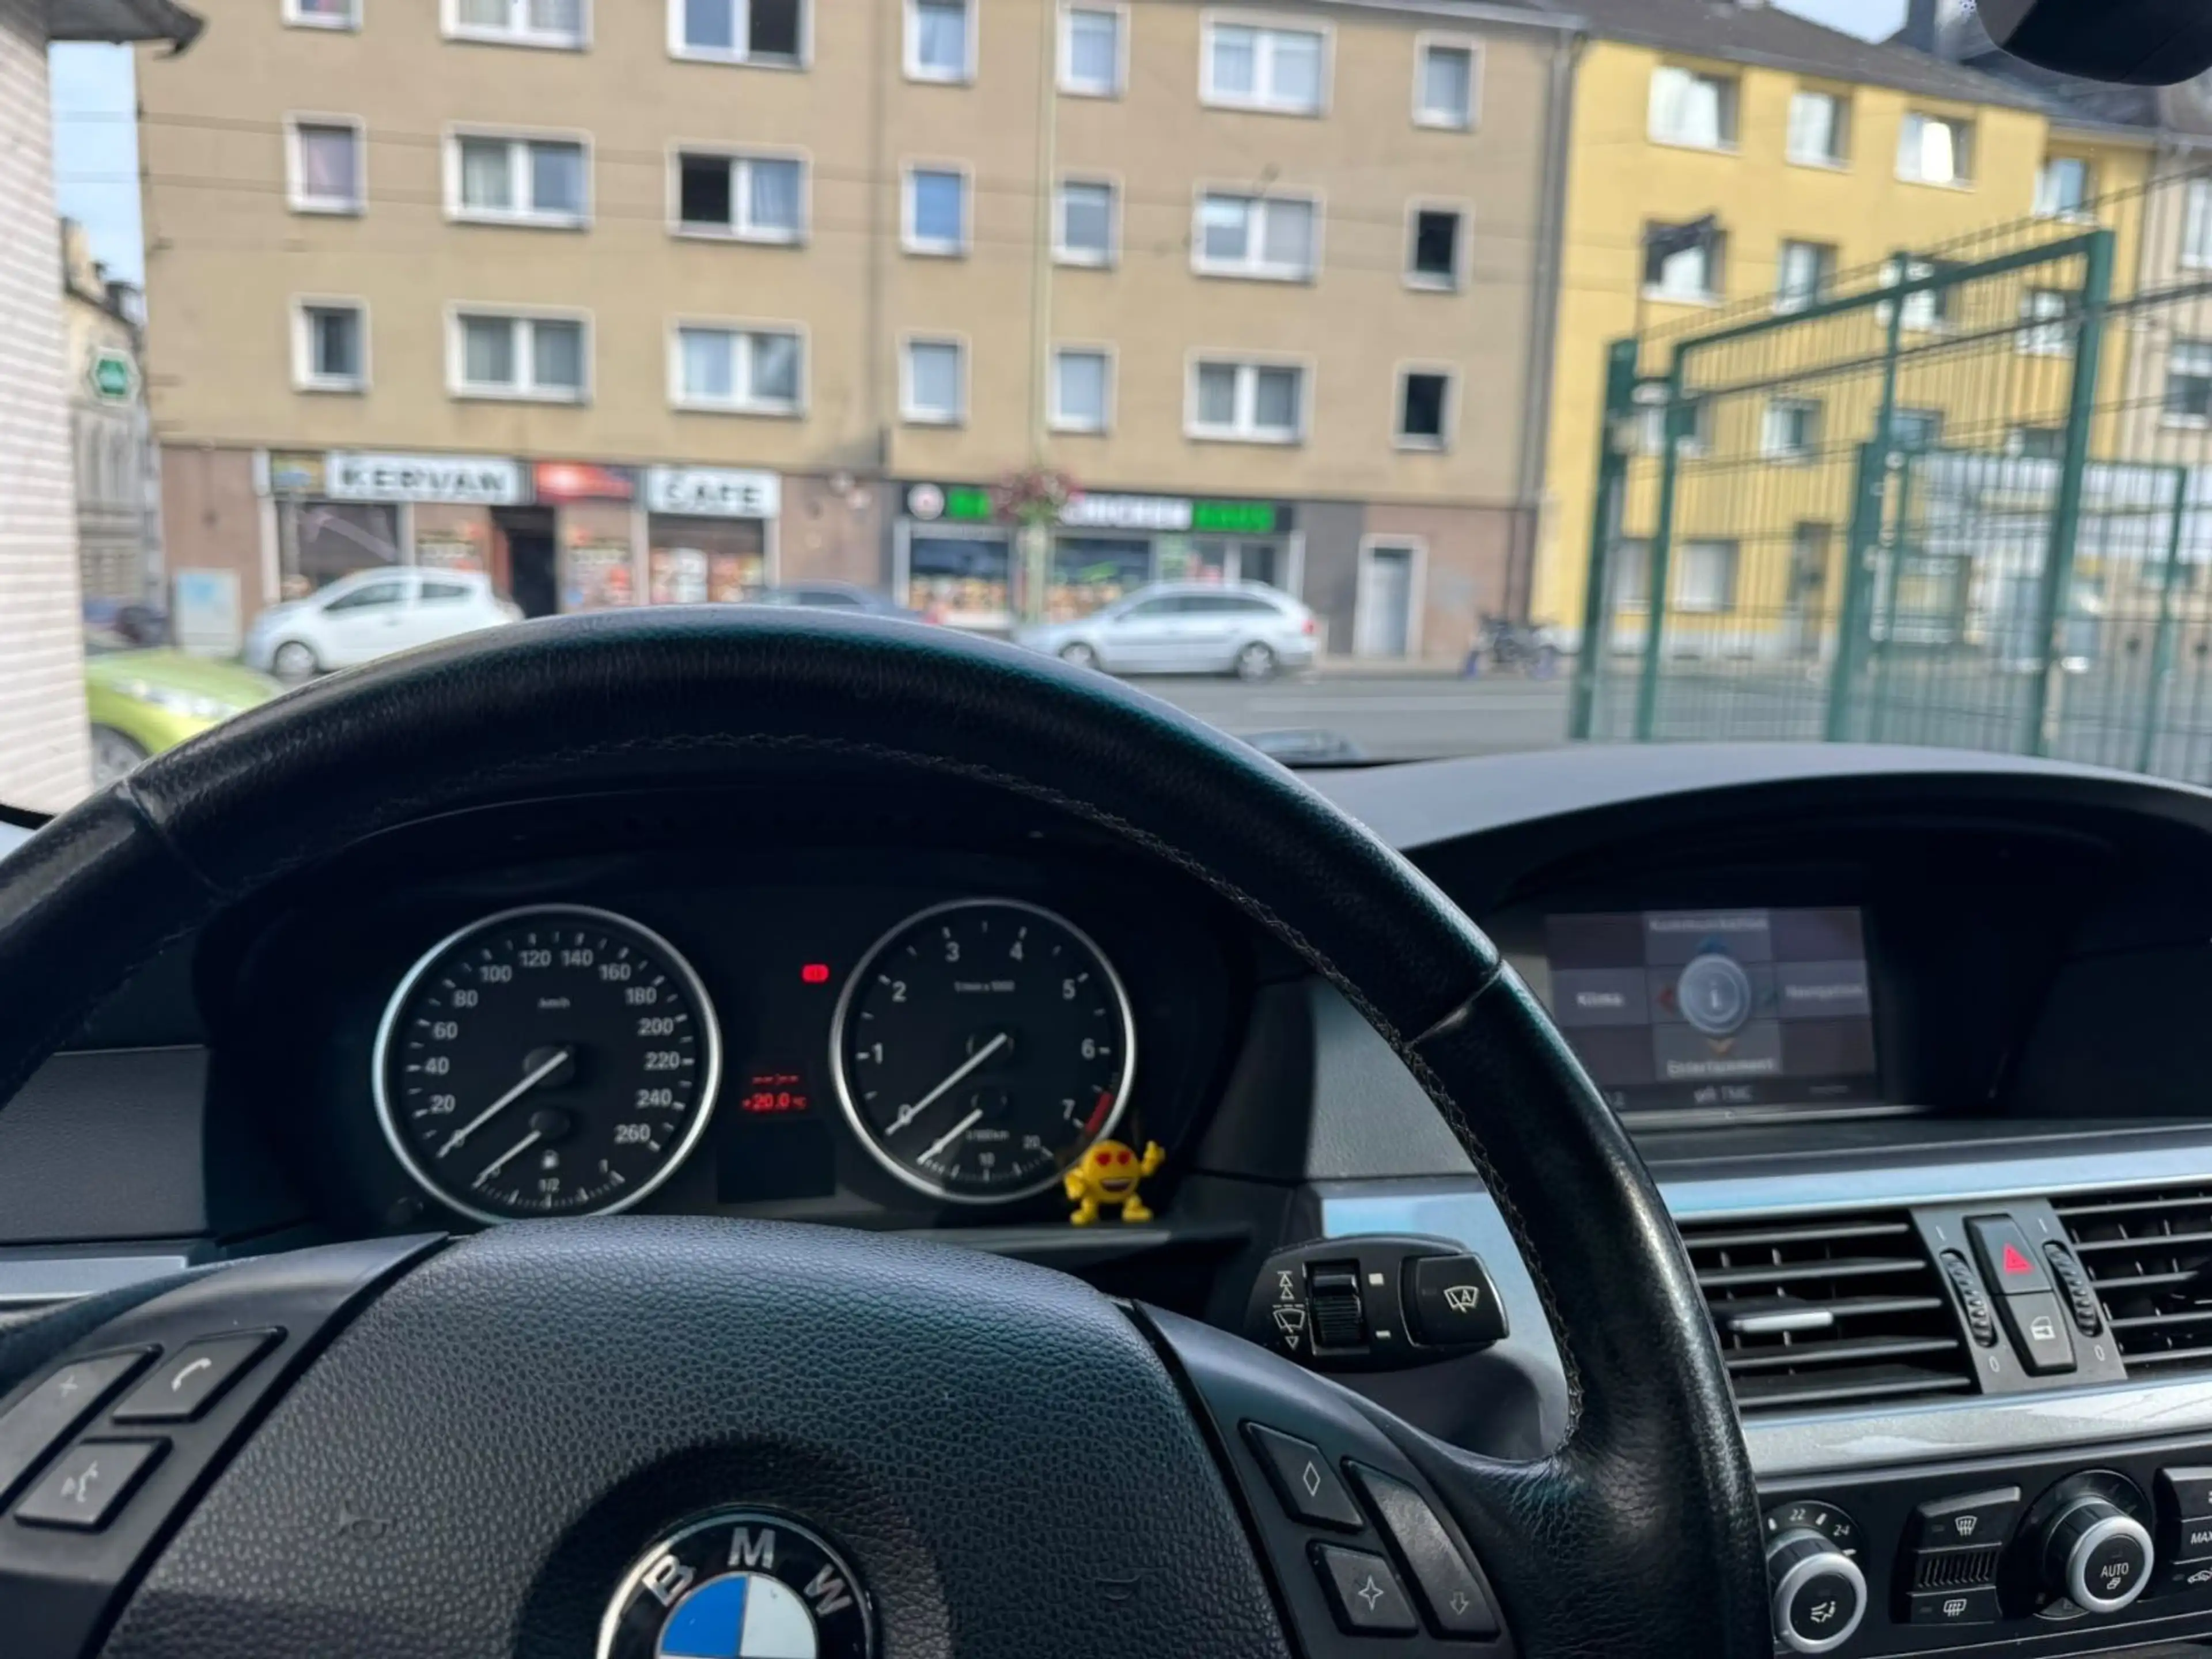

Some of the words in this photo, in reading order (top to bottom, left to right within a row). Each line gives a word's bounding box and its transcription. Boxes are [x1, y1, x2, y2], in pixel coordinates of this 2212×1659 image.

[520, 949, 552, 967] 120
[561, 949, 594, 967] 140
[945, 941, 960, 962] 3
[1010, 941, 1023, 961] 4
[480, 964, 513, 982] 100
[599, 963, 631, 980] 160
[453, 989, 479, 1007] 80
[625, 986, 657, 1005] 180
[892, 980, 906, 1002] 2
[1062, 979, 1075, 1000] 5
[433, 1021, 459, 1040] 60
[638, 1017, 674, 1036] 200
[872, 1041, 883, 1064] 1
[1081, 1037, 1095, 1060] 6
[424, 1056, 450, 1075] 40
[643, 1051, 680, 1070] 220
[430, 1094, 456, 1114] 20
[635, 1088, 673, 1109] 240
[1063, 1099, 1076, 1120] 7
[613, 1123, 651, 1145] 260
[1022, 1135, 1041, 1150] 20
[978, 1152, 995, 1167] 10
[1789, 1508, 1806, 1522] 22
[1832, 1524, 1851, 1537] 24
[641, 1526, 853, 1618] BMW
[2100, 1562, 2130, 1578] AUTO
